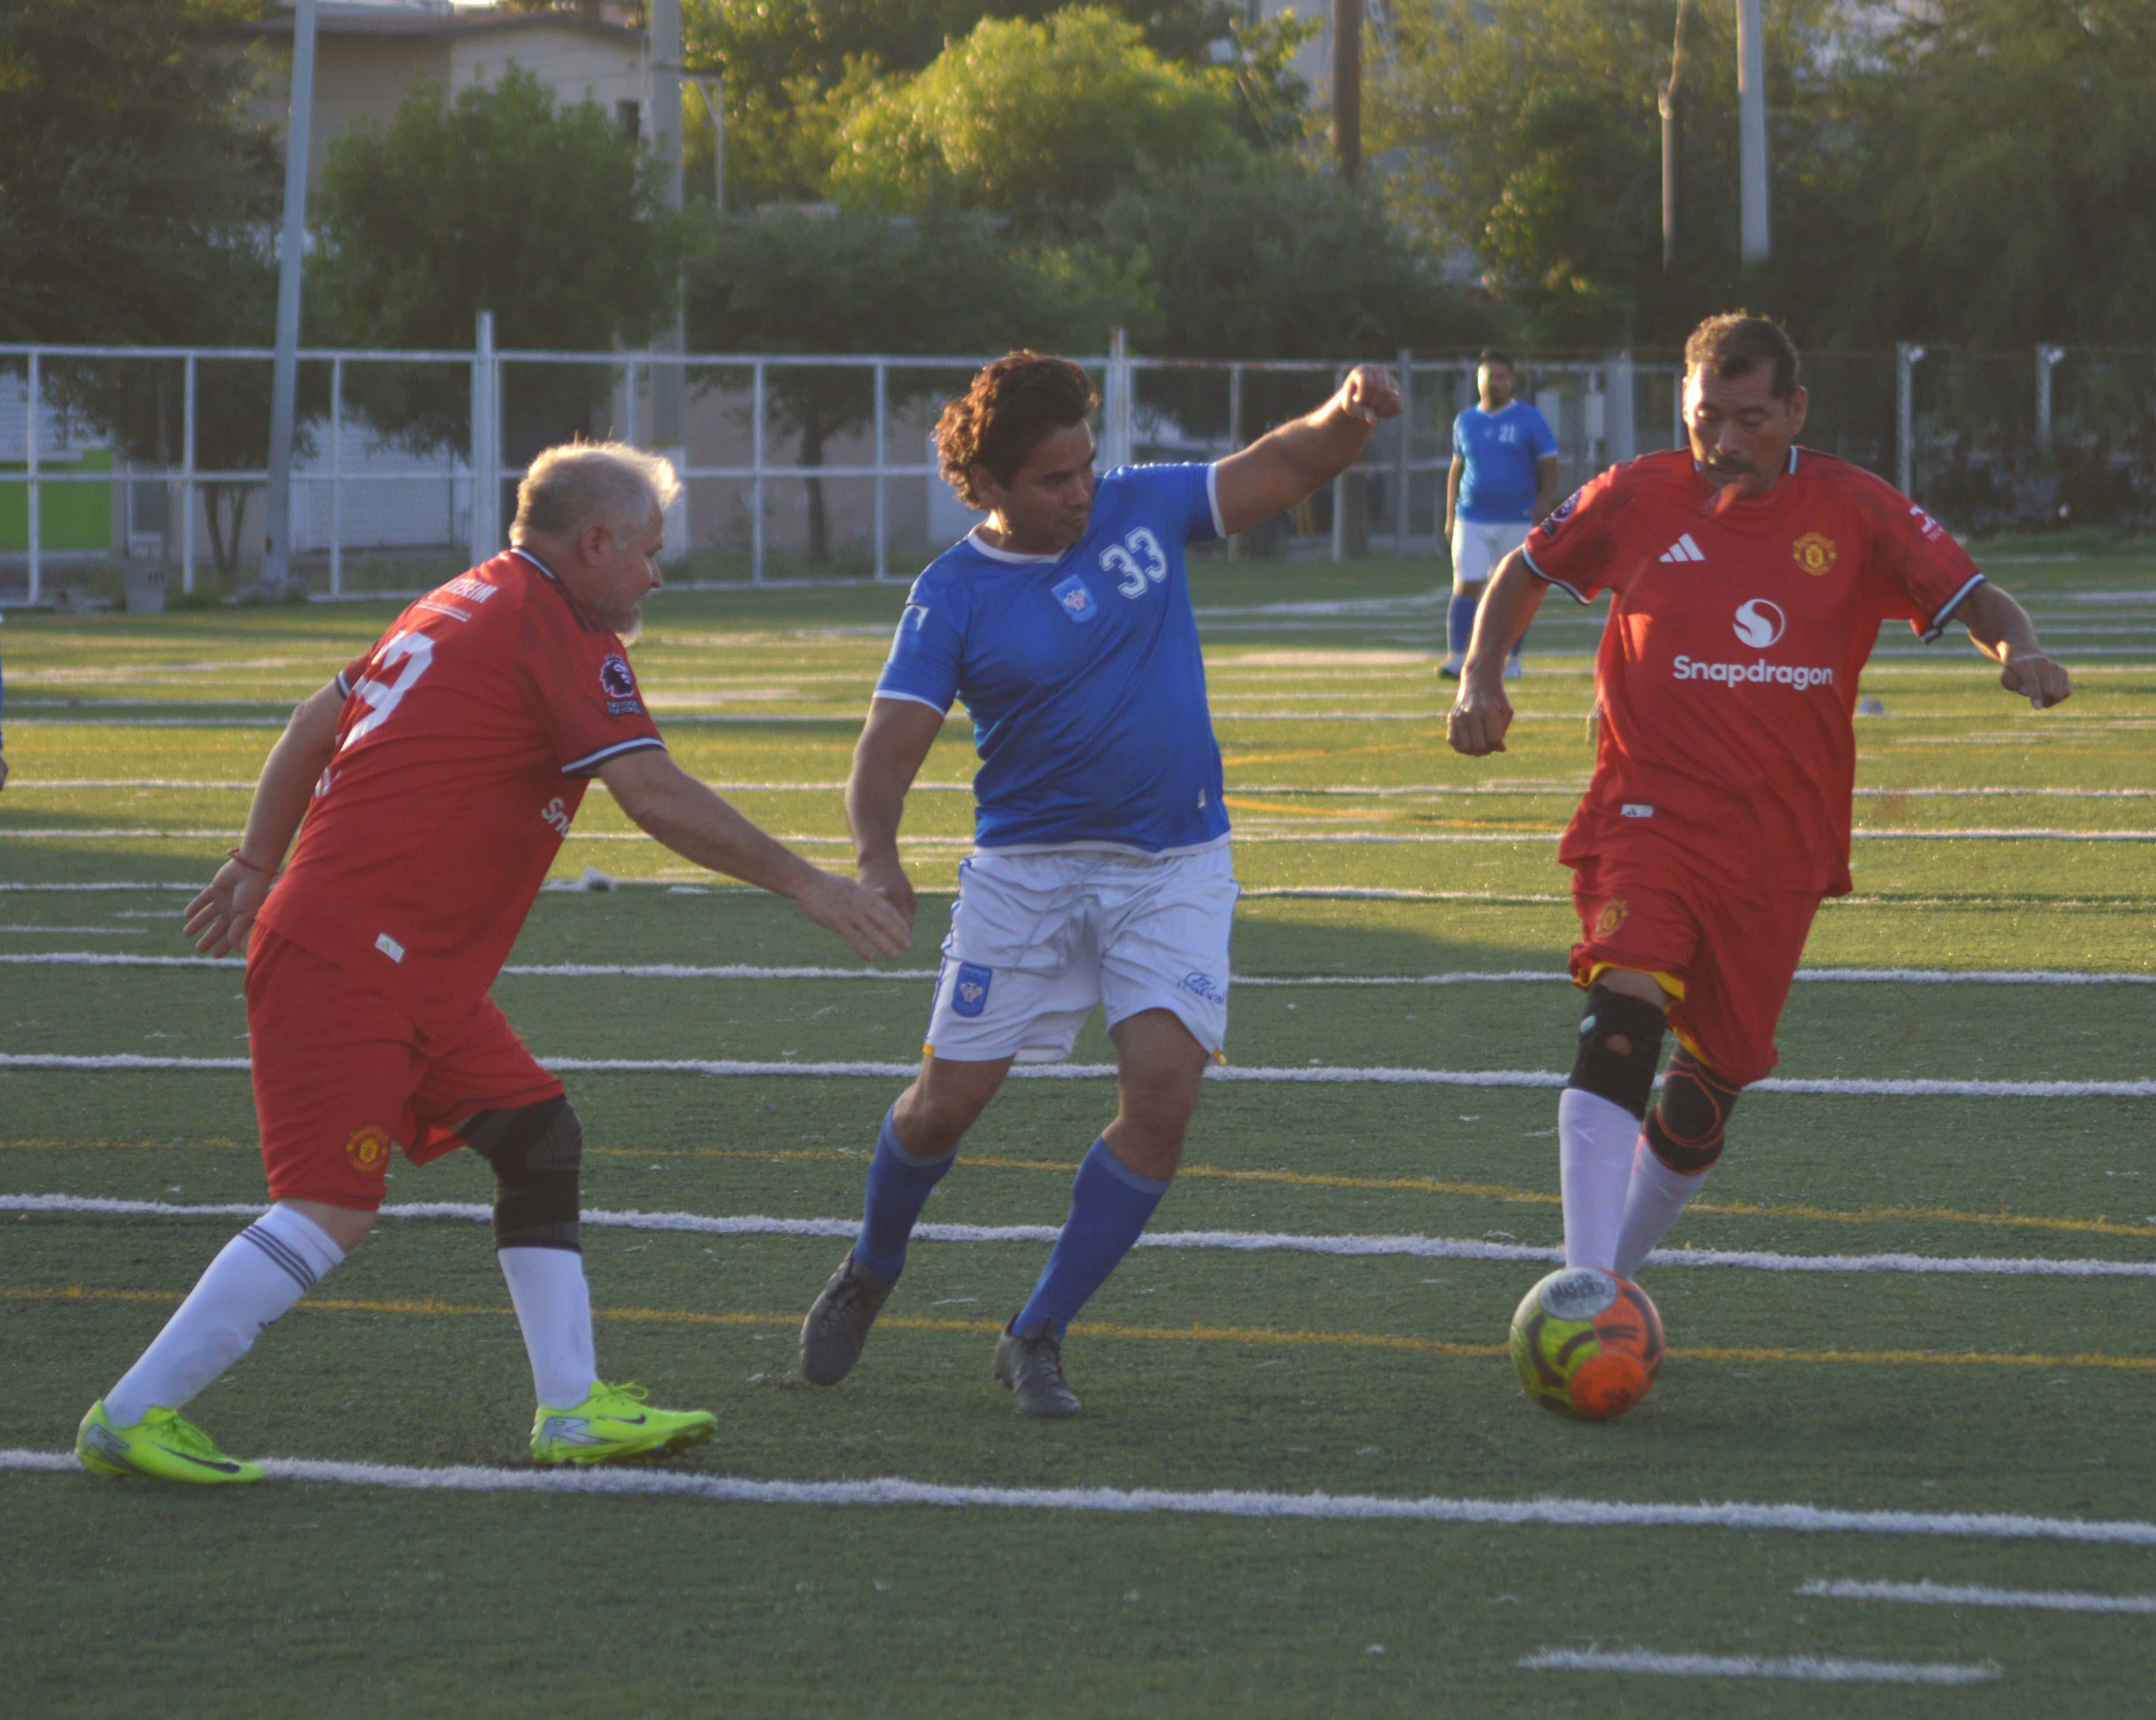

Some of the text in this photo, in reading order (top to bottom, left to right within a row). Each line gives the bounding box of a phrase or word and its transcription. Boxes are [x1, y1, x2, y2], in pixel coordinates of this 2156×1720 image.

[1499, 425, 1516, 443] 21
[1099, 527, 1167, 599] 33
[1673, 655, 1833, 690] Snapdragon
